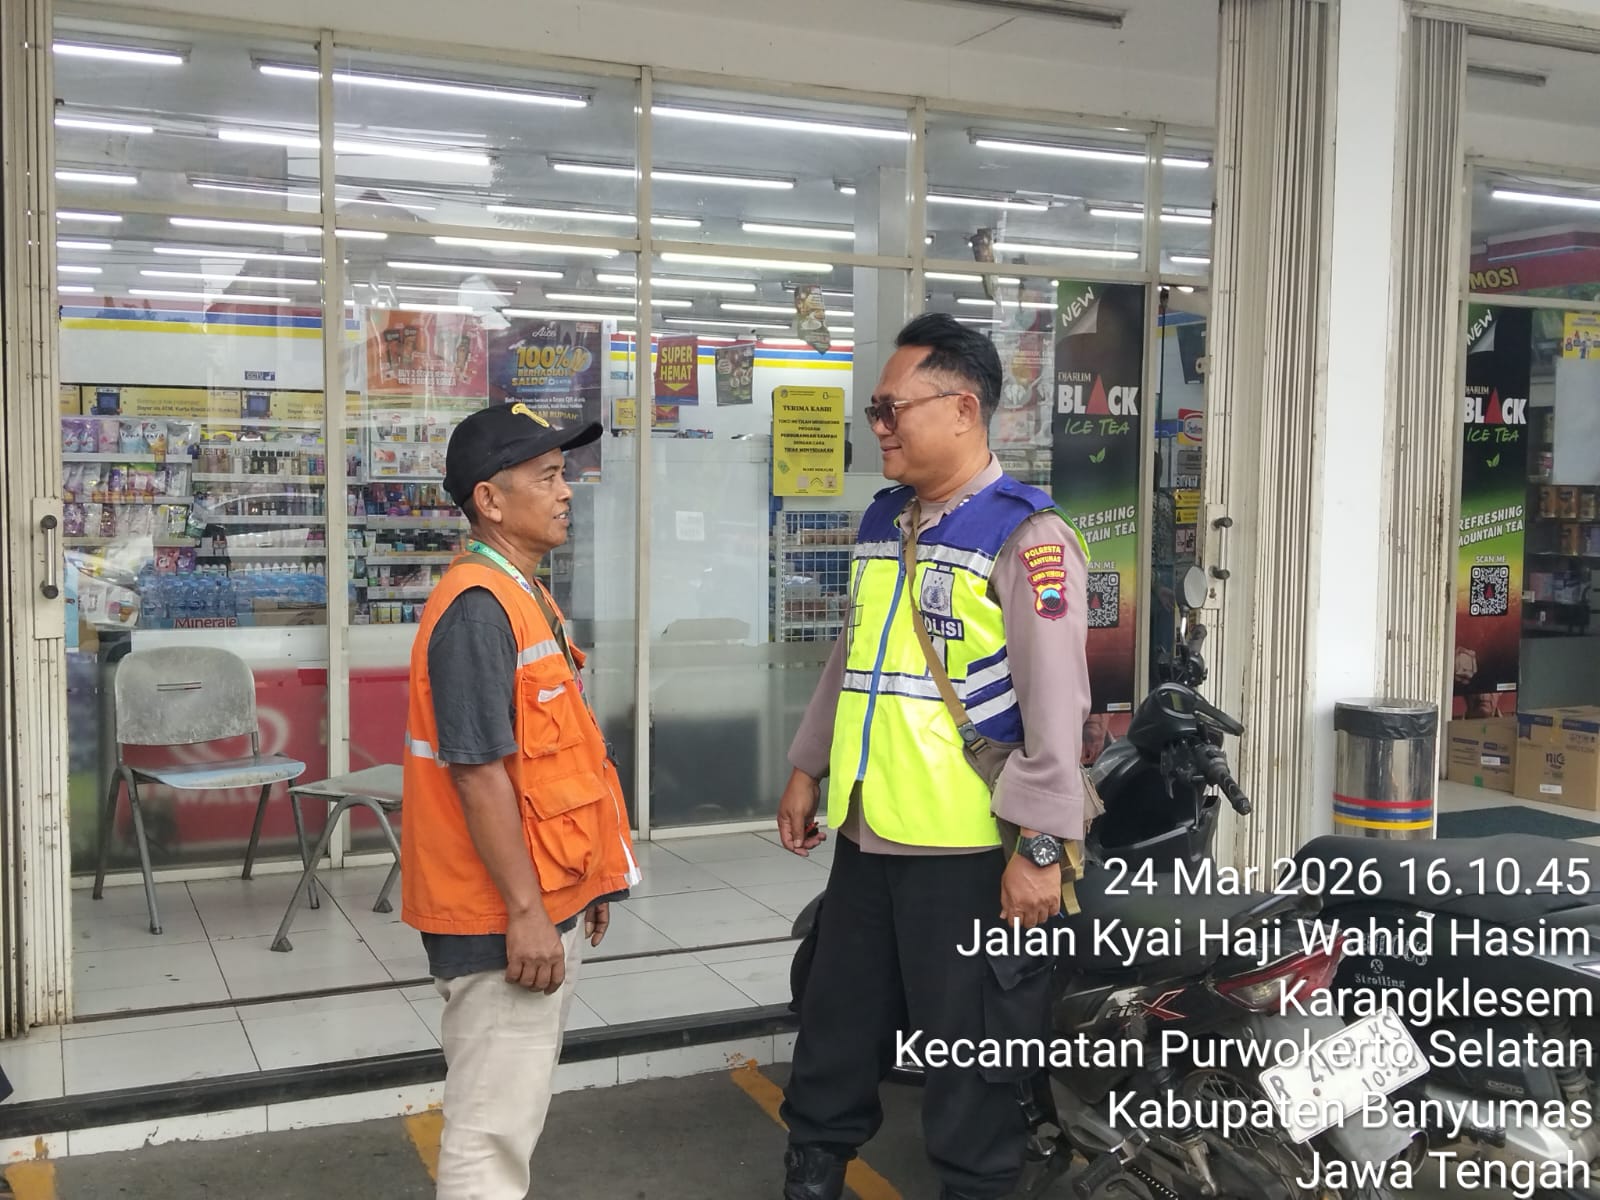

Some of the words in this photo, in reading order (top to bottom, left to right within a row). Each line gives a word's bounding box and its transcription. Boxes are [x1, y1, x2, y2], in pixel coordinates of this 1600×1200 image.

[1469, 267, 1519, 289] MOSI
[1061, 286, 1095, 326] NEW
[1467, 309, 1492, 345] NEW
[517, 346, 570, 369] 100%
[661, 346, 692, 363] SUPER
[660, 365, 692, 381] HEMAT
[1058, 372, 1091, 382] DJARUM
[511, 377, 544, 387] SALDO
[1058, 376, 1139, 416] BLACK
[1464, 390, 1527, 424] BLACK
[1065, 418, 1094, 435] ICE
[1100, 419, 1131, 436] TEA
[1466, 427, 1491, 443] ICE
[1494, 427, 1520, 443] TEA
[1459, 505, 1524, 531] REFRESHING
[1115, 521, 1136, 537] TEA
[1506, 519, 1524, 537] TEA
[1023, 545, 1063, 561] POLRESTA
[1028, 555, 1062, 568] BANYUMAS
[1475, 555, 1495, 563] SCAN
[1103, 561, 1116, 569] ME
[174, 617, 237, 629] Minerale
[924, 618, 963, 638] OLISI
[1269, 1075, 1291, 1100] R
